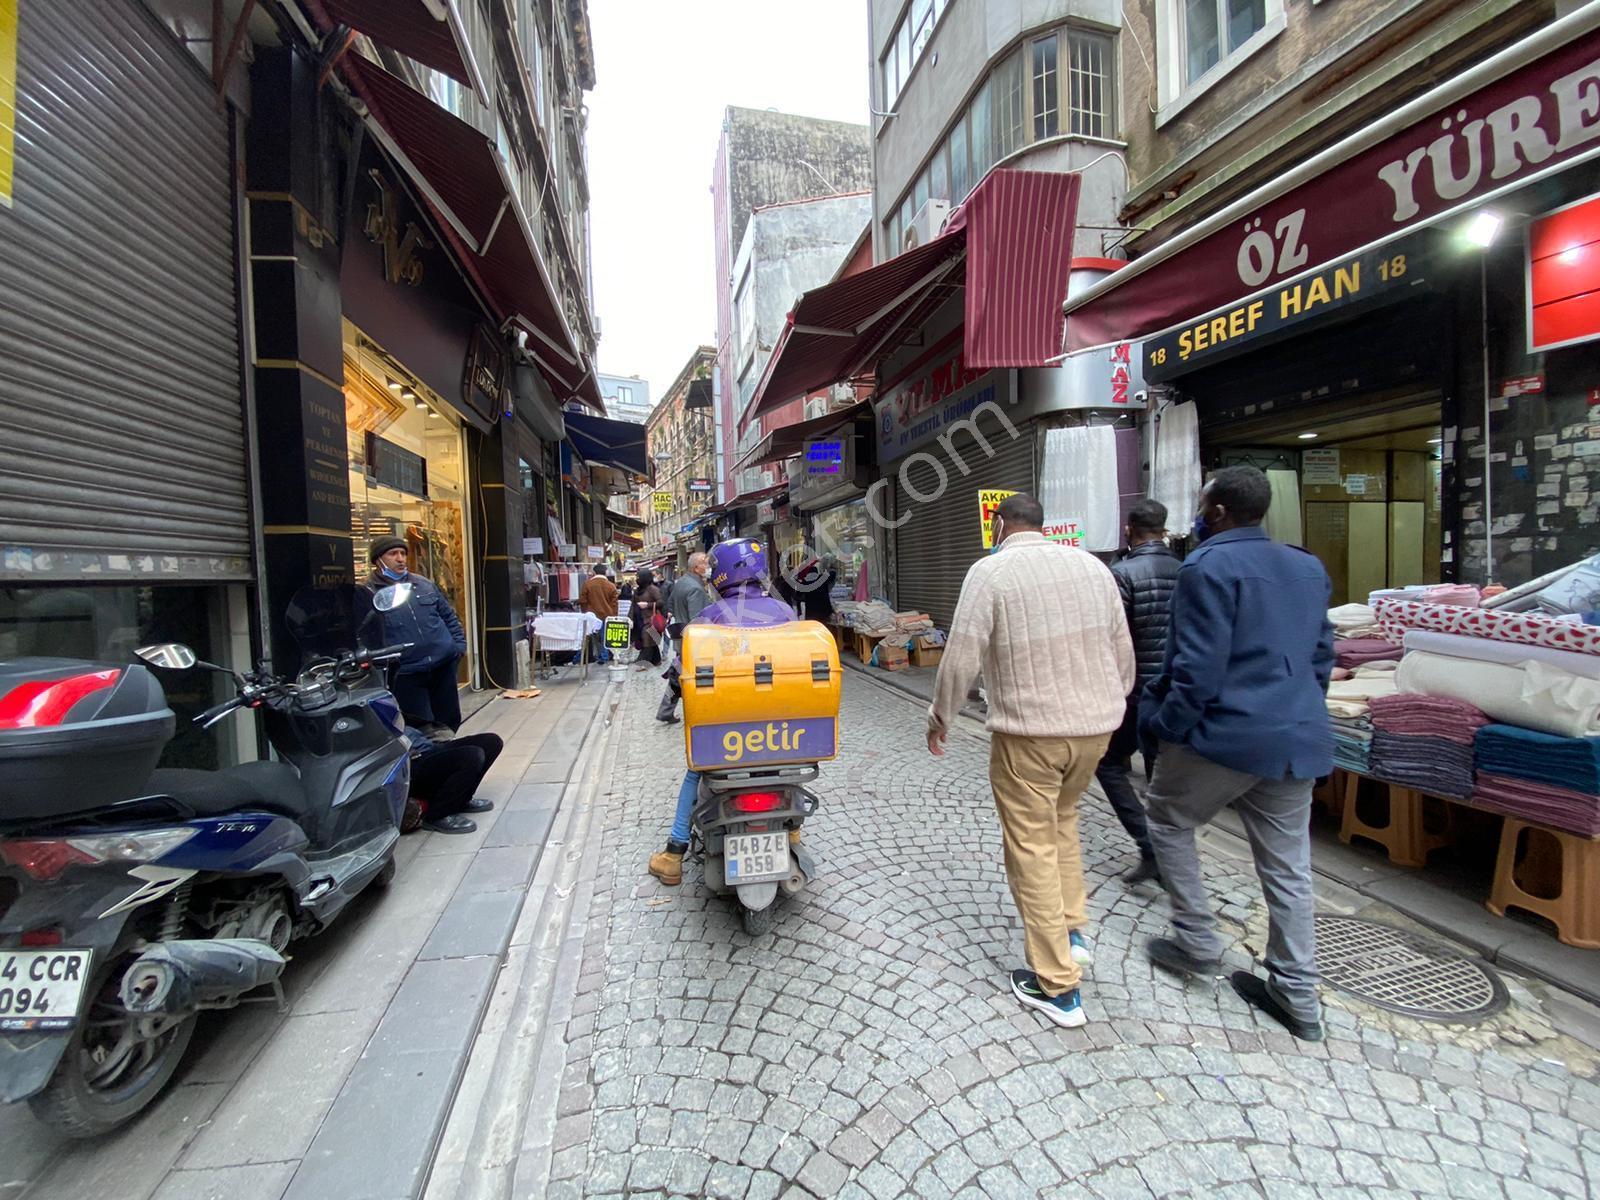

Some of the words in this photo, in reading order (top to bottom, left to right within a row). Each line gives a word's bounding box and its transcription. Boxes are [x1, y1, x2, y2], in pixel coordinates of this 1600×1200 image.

[1237, 209, 1308, 287] ÖZ
[1378, 58, 1600, 222] YÜRE
[1150, 348, 1166, 367] 18
[1178, 301, 1264, 360] ŞEREF
[1280, 261, 1360, 319] HAN
[1378, 255, 1407, 281] 18
[607, 628, 628, 642] BÜFE
[722, 722, 806, 761] getir
[29, 955, 82, 981] CCR
[1342, 948, 1424, 973] TELEFON
